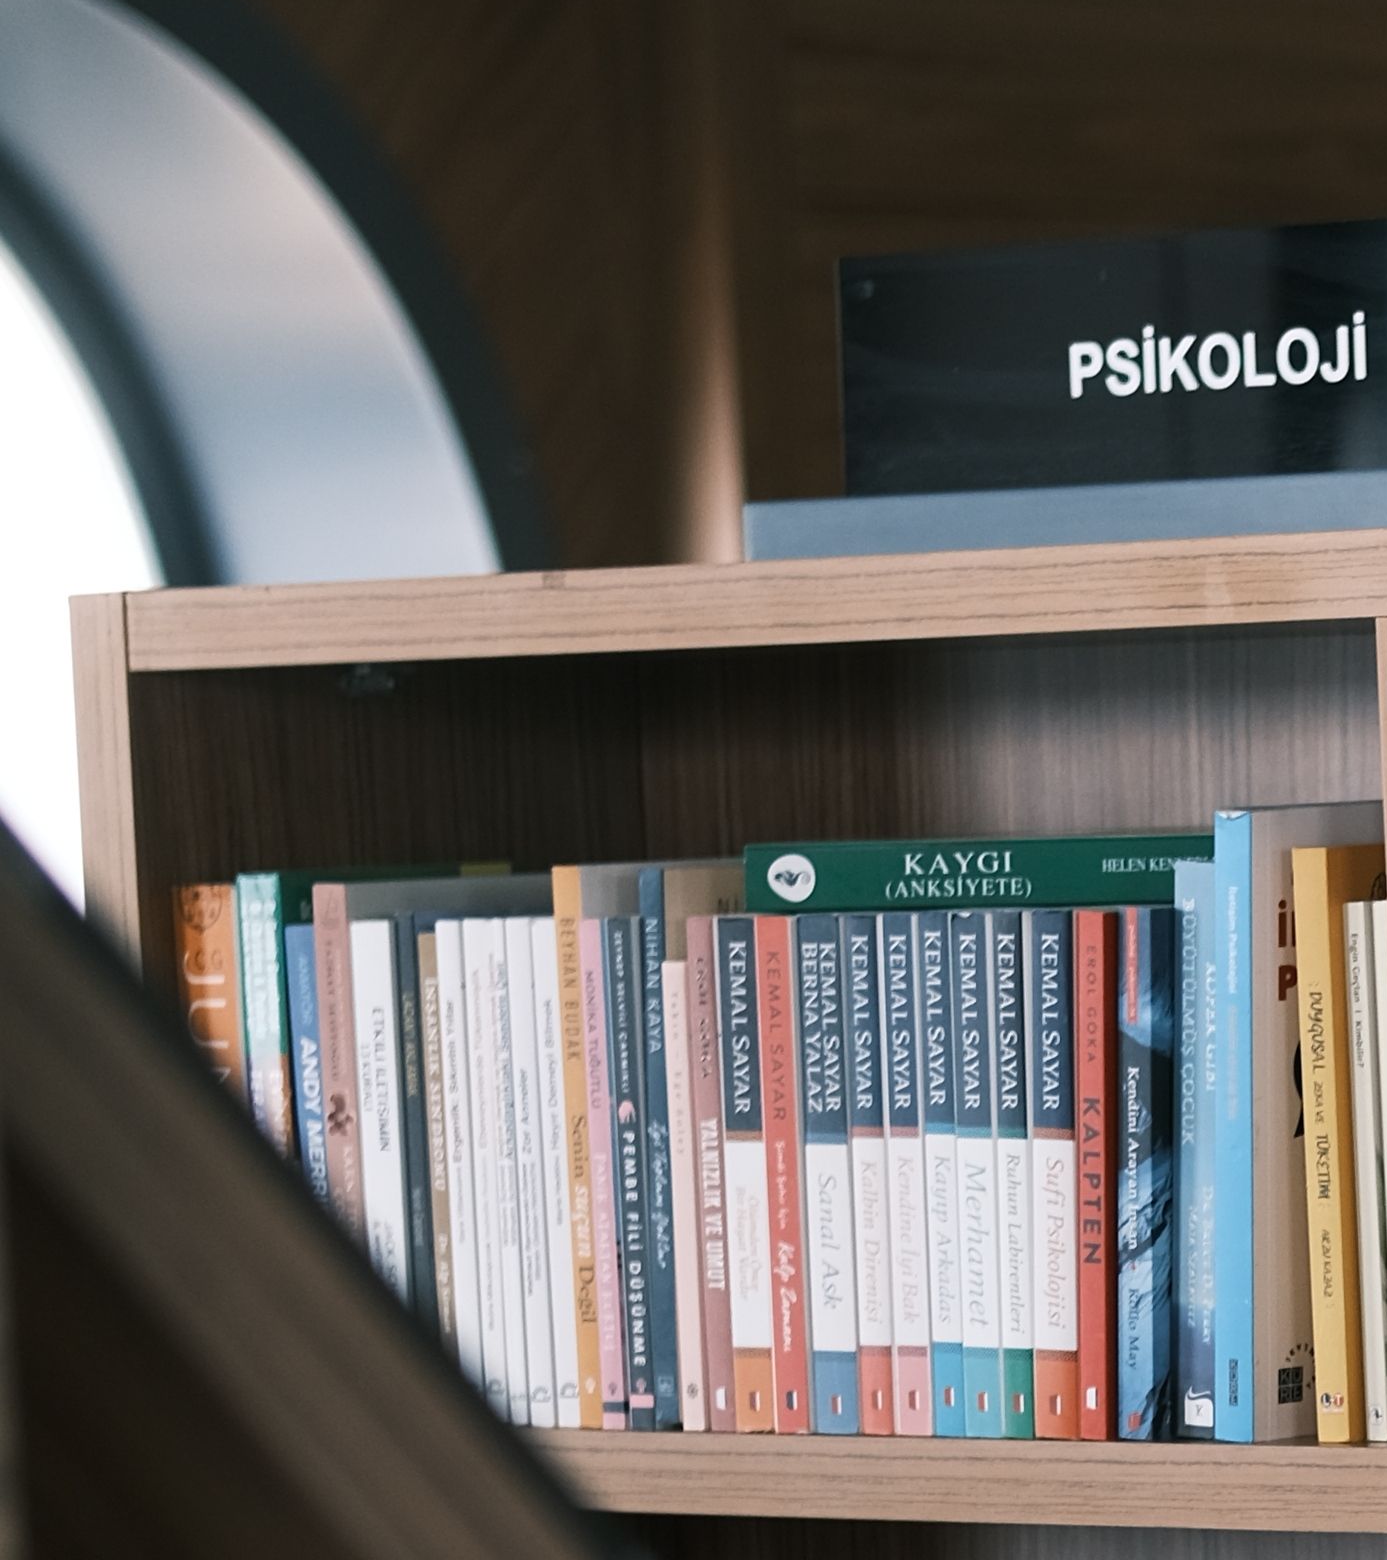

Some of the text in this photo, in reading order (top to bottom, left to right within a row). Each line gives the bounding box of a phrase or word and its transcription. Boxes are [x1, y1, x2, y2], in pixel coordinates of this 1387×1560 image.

[1069, 312, 1366, 399] PSİKOLOJİ
[903, 852, 1012, 875] KAYGI
[1040, 932, 1061, 1111] KEMAL SAYAR
[1044, 1156, 1067, 1329] Sufi Psikolojisi
[1082, 1097, 1102, 1265] KALPTEN
